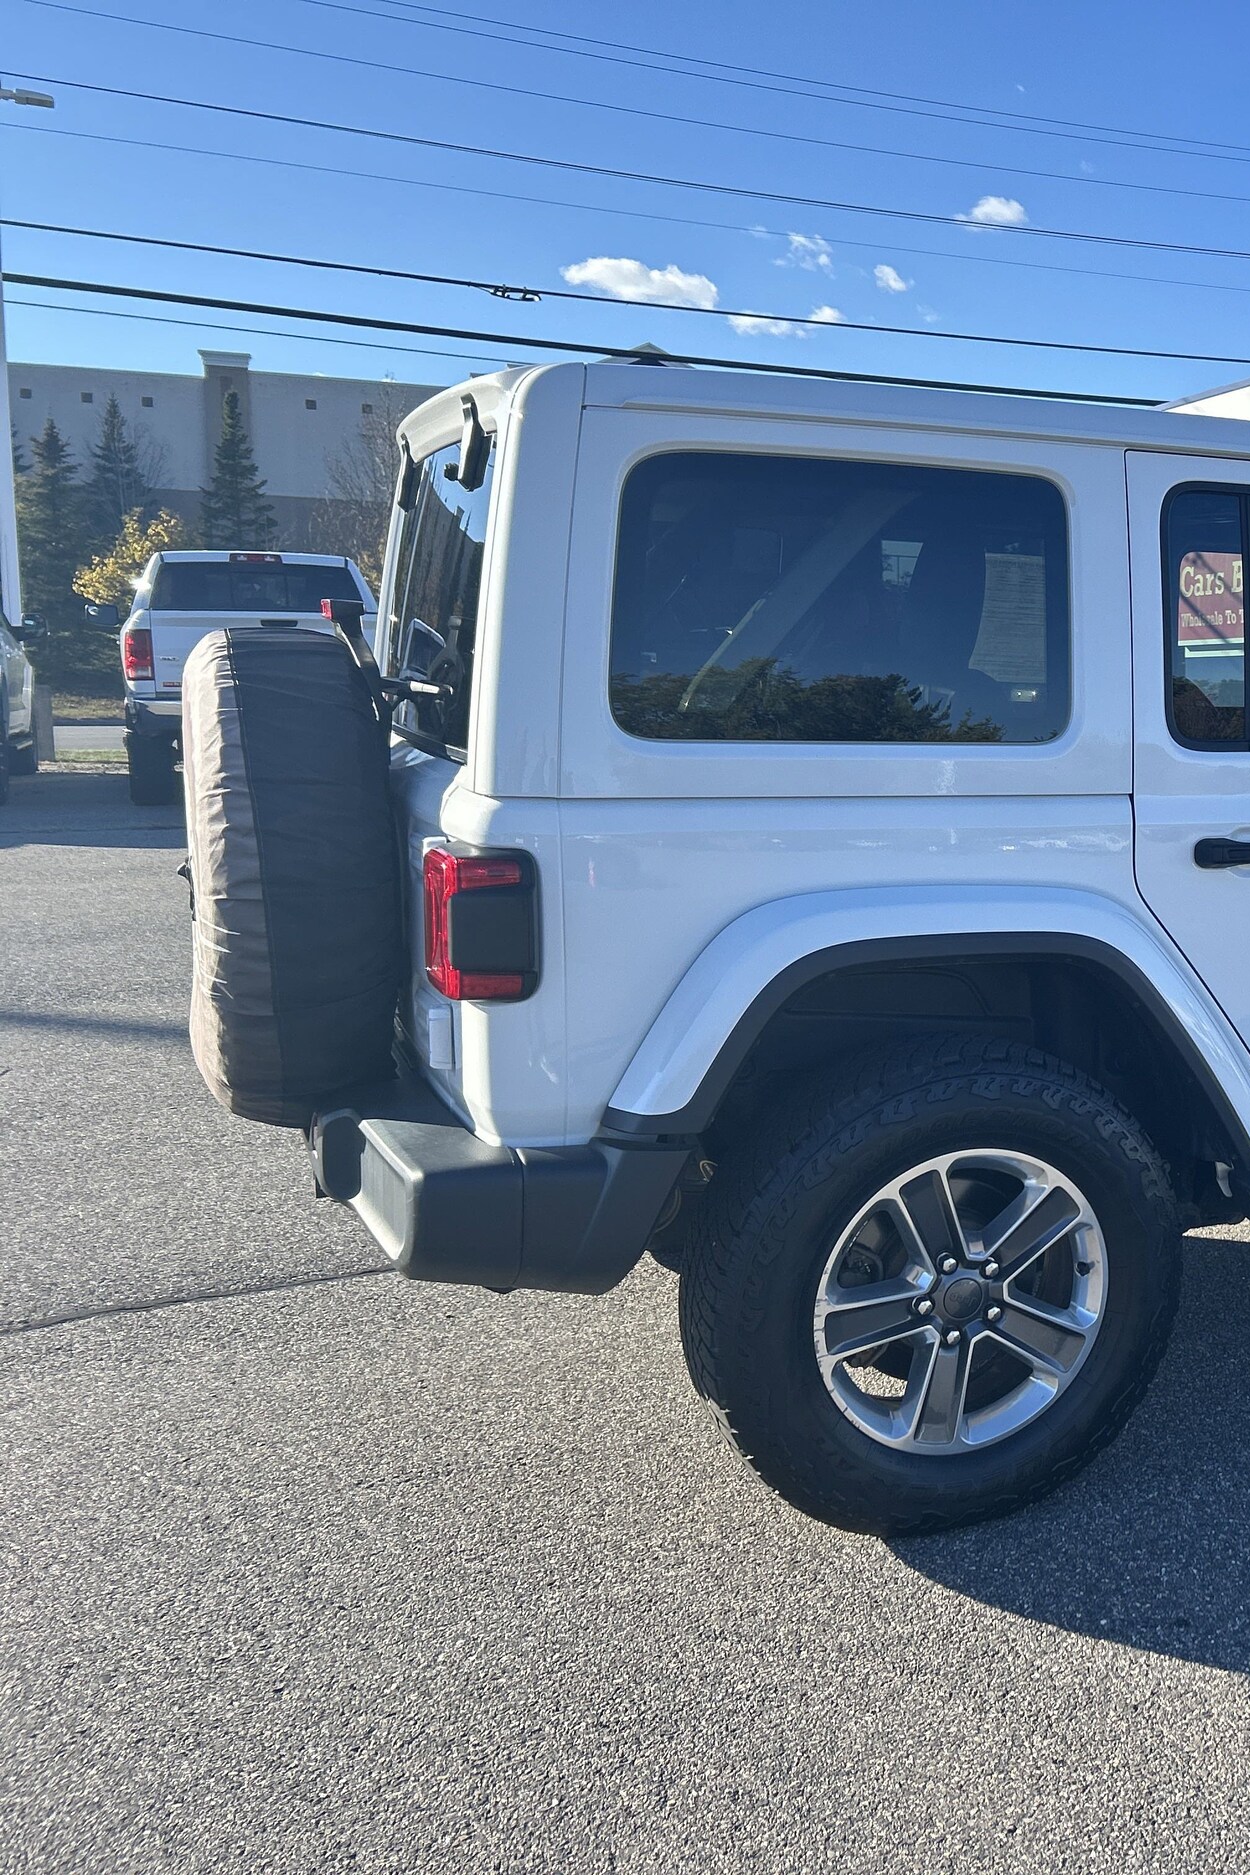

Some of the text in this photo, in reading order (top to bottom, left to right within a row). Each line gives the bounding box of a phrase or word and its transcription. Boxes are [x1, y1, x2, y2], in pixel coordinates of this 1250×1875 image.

[1180, 566, 1225, 598] Cars
[1181, 611, 1223, 627] Wholale
[1225, 610, 1237, 624] To
